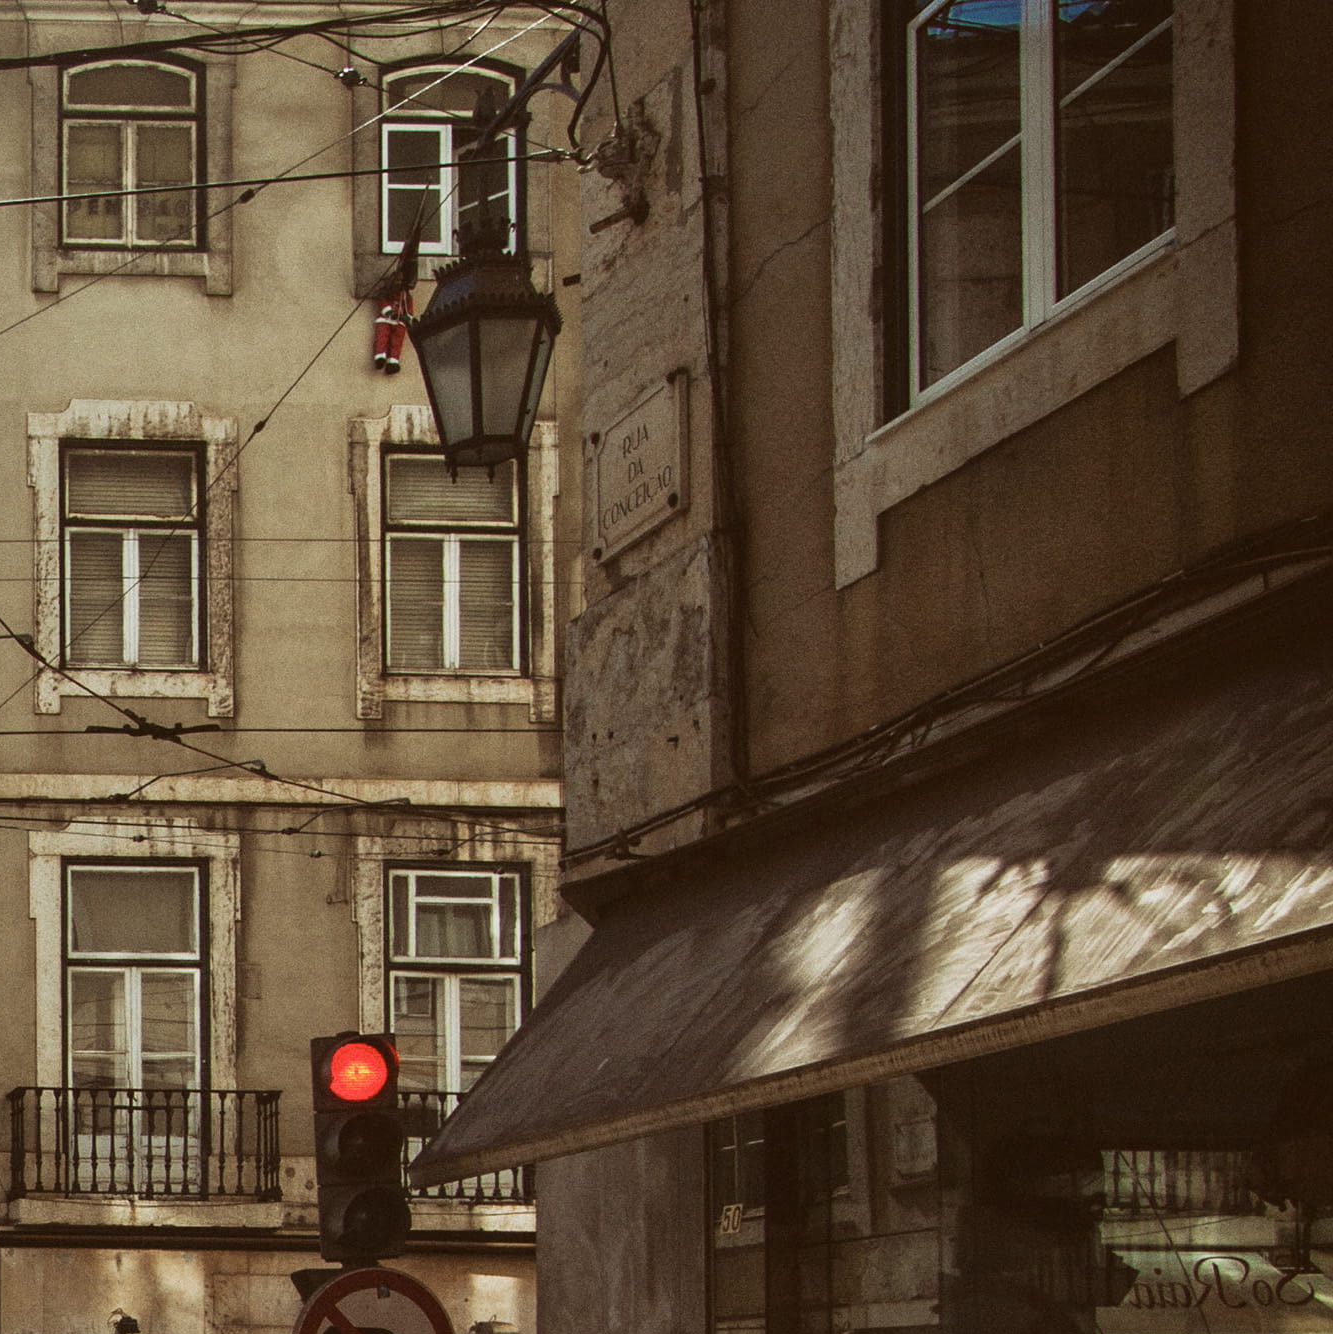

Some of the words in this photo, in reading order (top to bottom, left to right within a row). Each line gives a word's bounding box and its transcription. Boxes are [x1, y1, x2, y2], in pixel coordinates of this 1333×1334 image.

[622, 423, 650, 459] RUA
[627, 458, 645, 485] DA
[722, 1205, 742, 1233] 50
